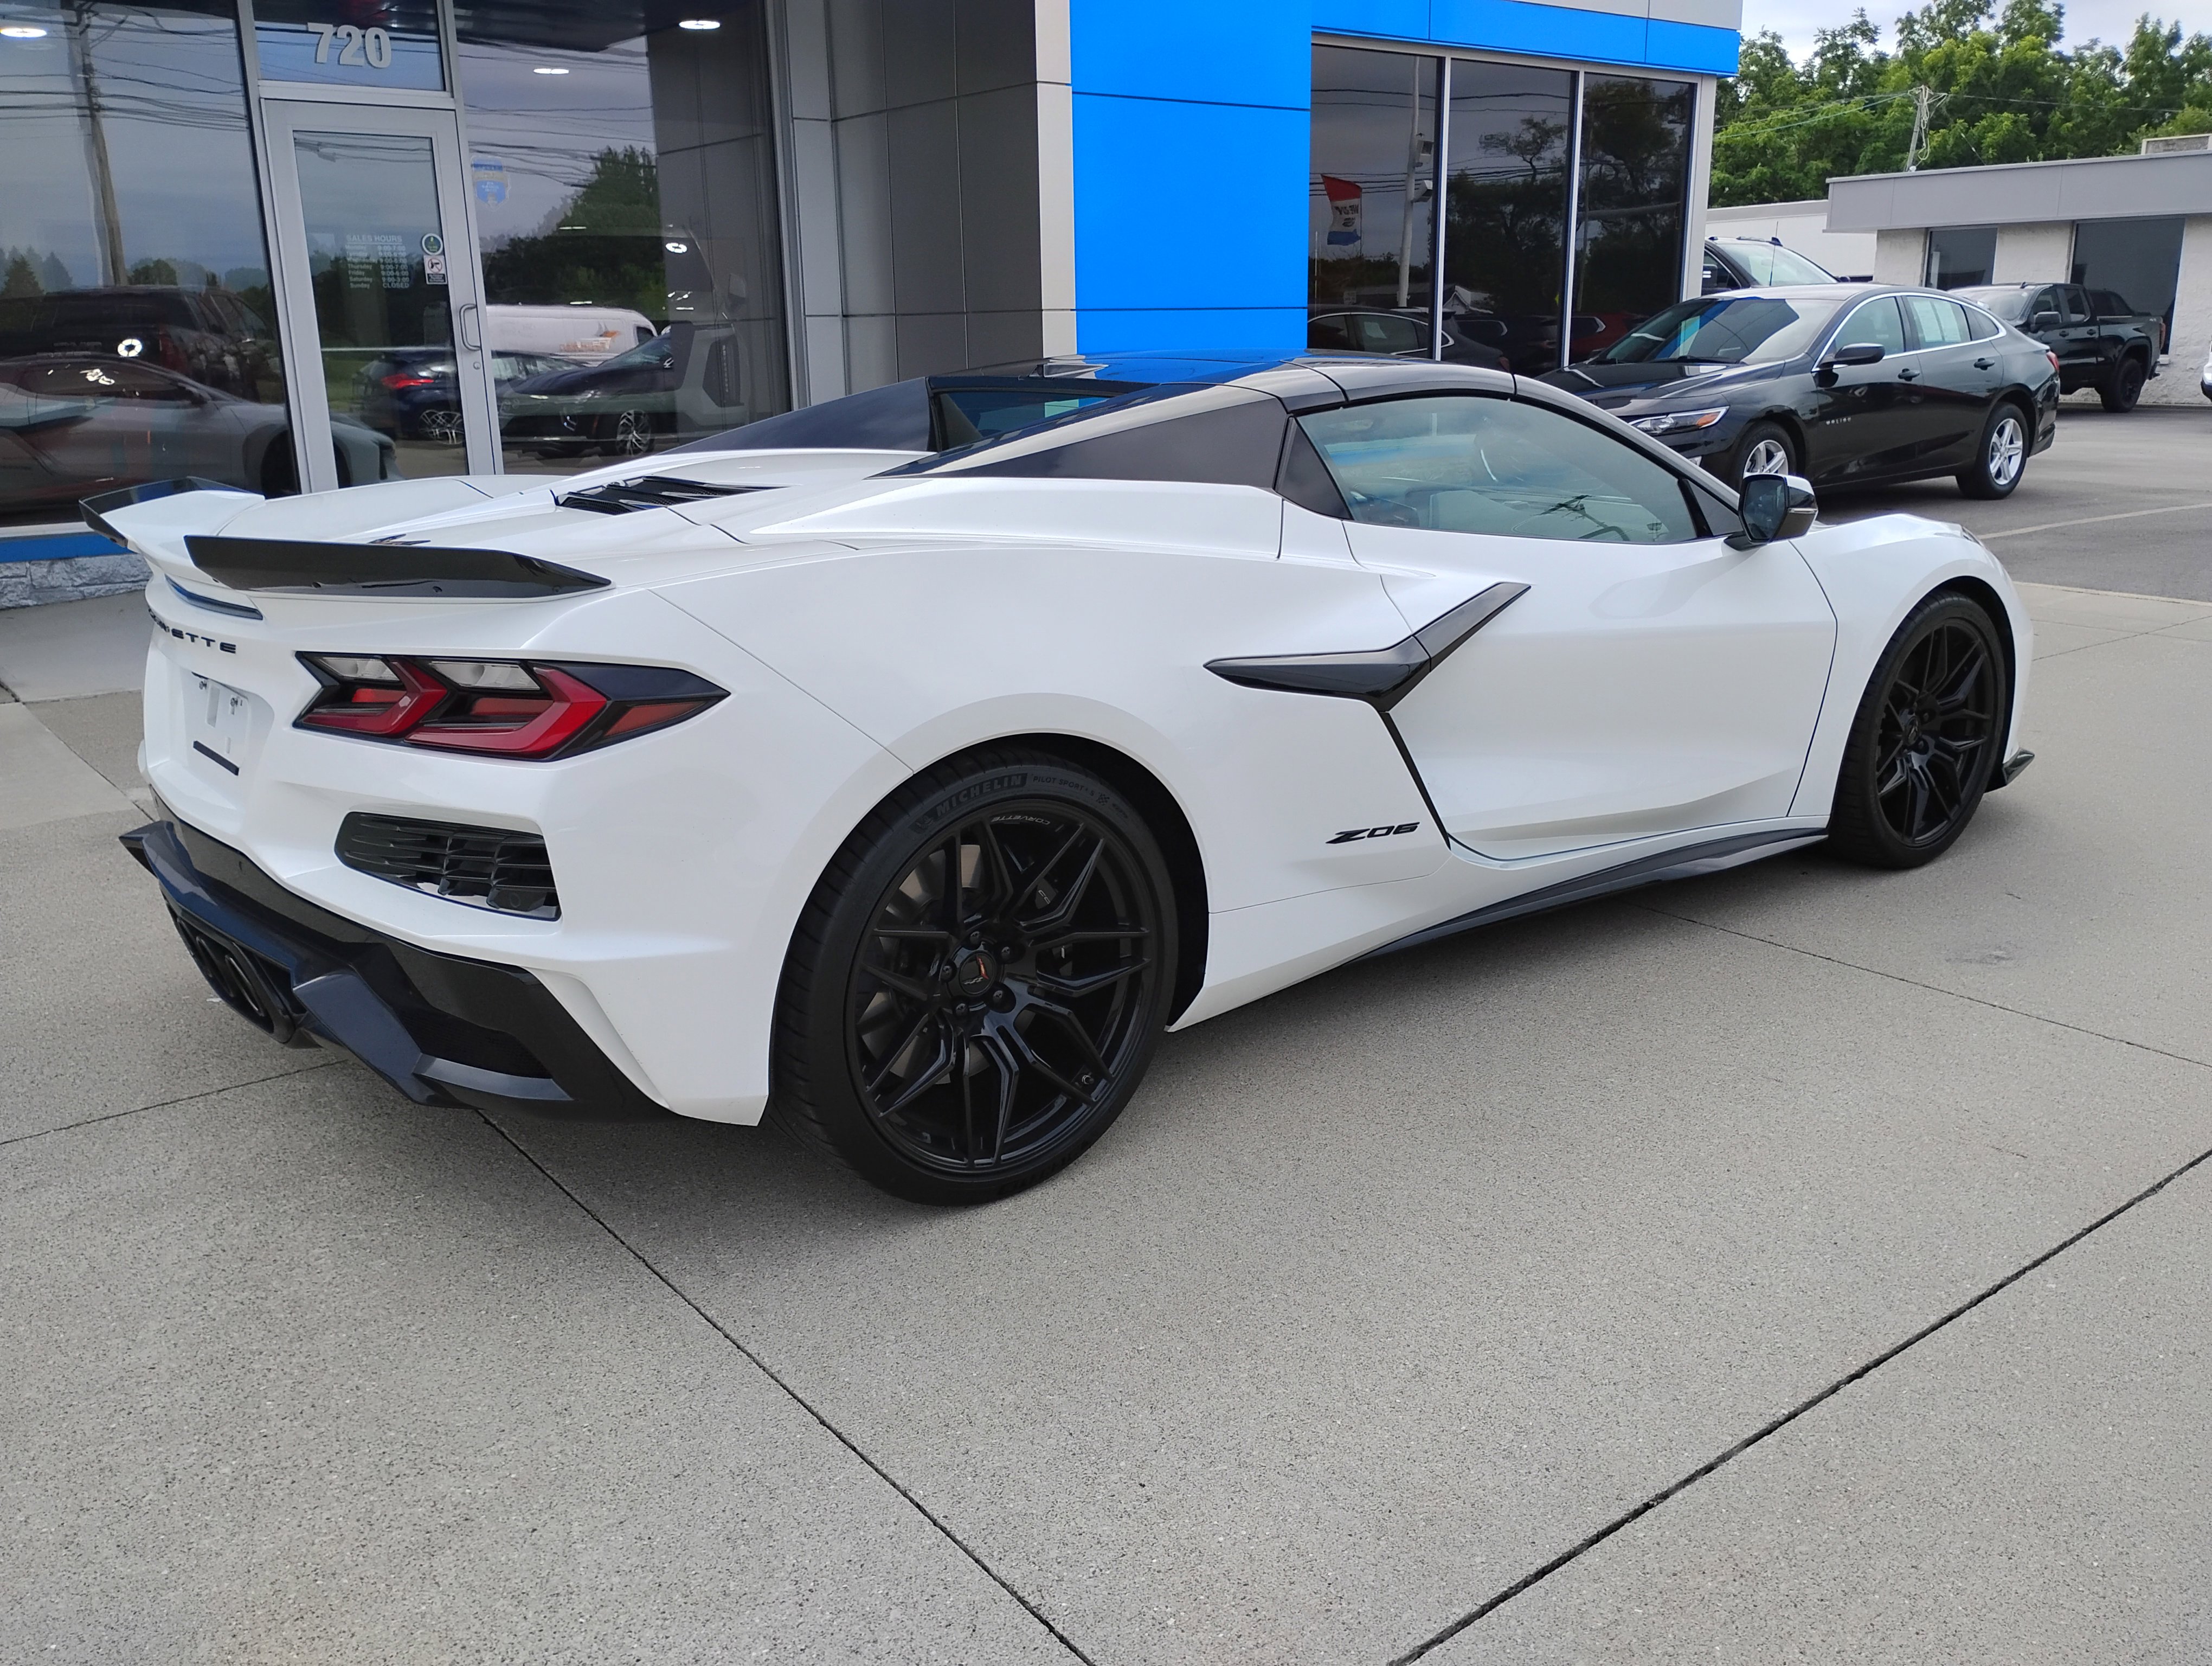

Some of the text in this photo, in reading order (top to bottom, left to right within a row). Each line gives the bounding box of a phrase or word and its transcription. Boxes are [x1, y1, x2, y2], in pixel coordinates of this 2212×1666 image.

[307, 22, 391, 68] 720
[148, 608, 237, 654] ORVETTE
[936, 776, 1021, 817] MICHELIN
[1059, 779, 1084, 791] SPORT
[991, 815, 1051, 825] CORVETTE
[1325, 822, 1420, 844] Z06
